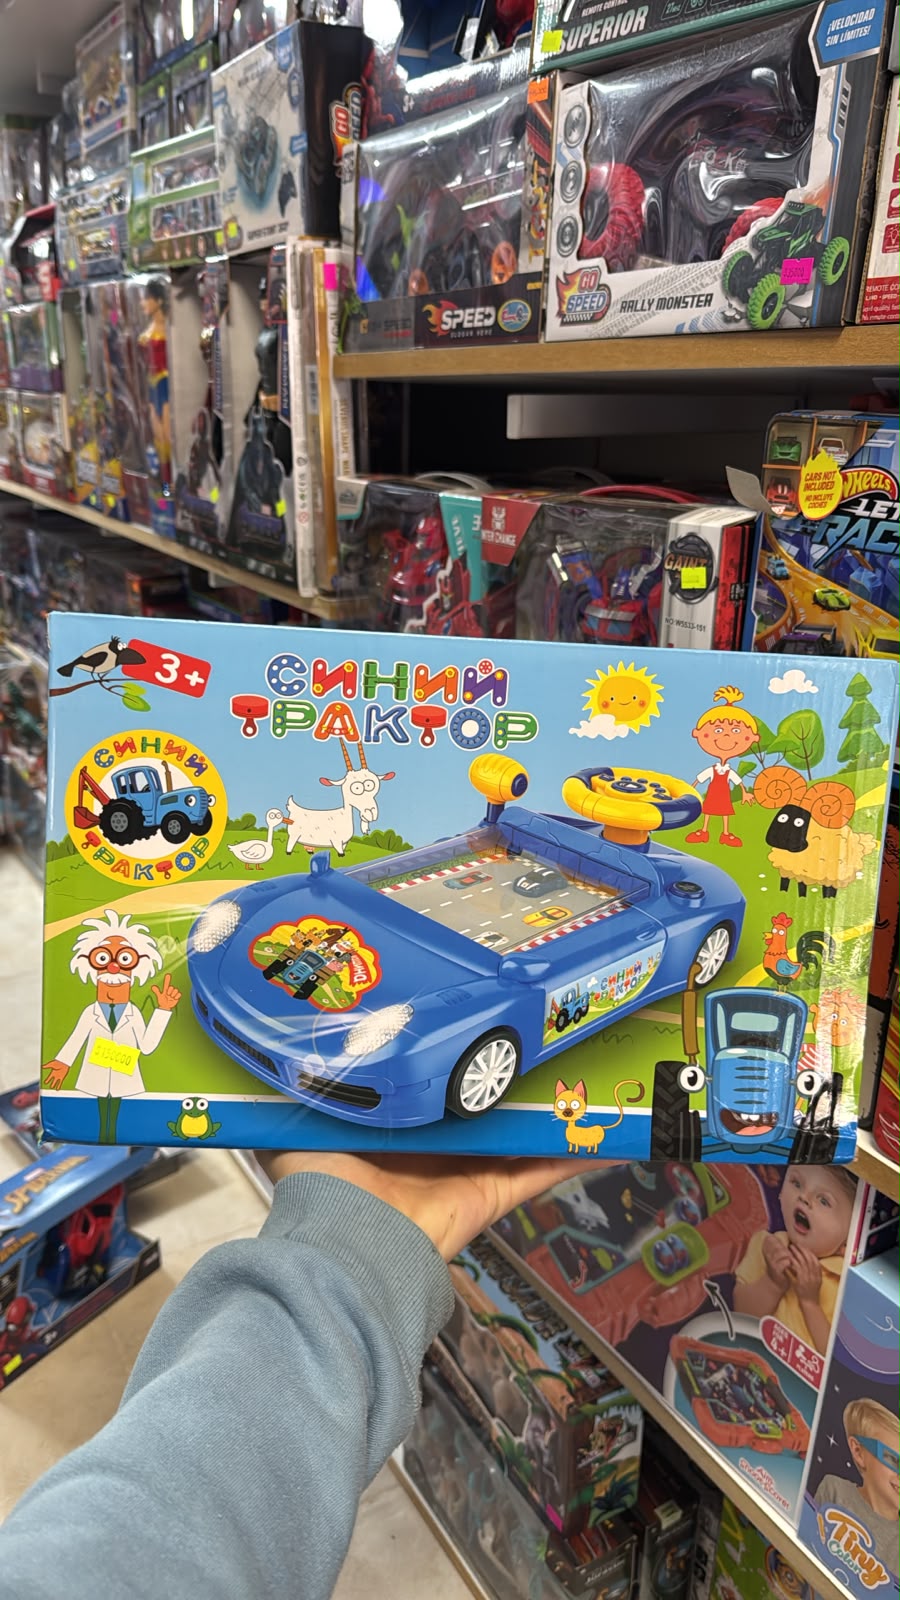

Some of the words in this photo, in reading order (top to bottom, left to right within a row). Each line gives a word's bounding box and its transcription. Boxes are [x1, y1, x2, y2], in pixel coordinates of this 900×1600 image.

[559, 6, 649, 54] SUPERIOR
[825, 34, 839, 47] SIN
[840, 25, 872, 43] LÍMITES!
[827, 8, 875, 35] ¡VELOCIDAD
[579, 271, 599, 291] GO
[566, 295, 606, 312] SPEED
[620, 299, 653, 313] RALLY
[656, 293, 713, 311] MONSTER
[440, 307, 496, 331] SPEED
[804, 472, 822, 481] CARS
[823, 471, 837, 480] NOT
[804, 481, 836, 491] INCLUDED
[814, 493, 834, 502] INCLUYE
[155, 653, 204, 687] 3+
[266, 653, 508, 706] СИНИЙ
[230, 694, 539, 749] ТРАКТОР
[94, 736, 208, 777] СИНИЙ
[81, 830, 210, 880] ТРАКТОР
[593, 973, 646, 1004] ТРАКТОР
[600, 960, 642, 991] СИНИЙ
[770, 1337, 788, 1358] 4+
[826, 1510, 890, 1588] Tiny
[828, 1539, 863, 1574] Color
